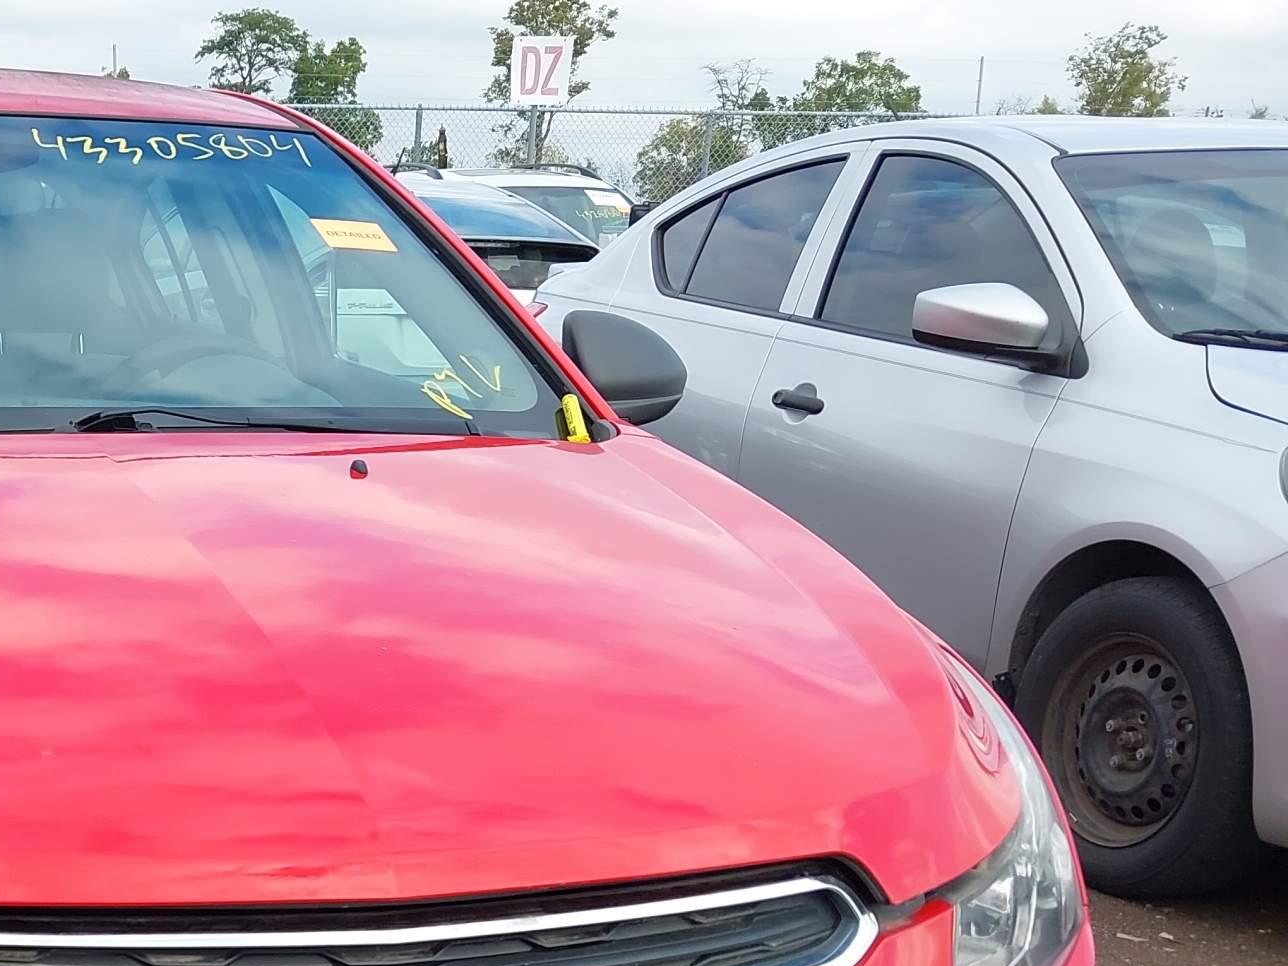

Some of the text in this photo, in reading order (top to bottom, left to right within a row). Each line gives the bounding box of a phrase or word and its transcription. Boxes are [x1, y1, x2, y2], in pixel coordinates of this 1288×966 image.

[520, 46, 563, 96] DZ
[31, 128, 312, 167] 43305804
[325, 230, 382, 240] DETAILED
